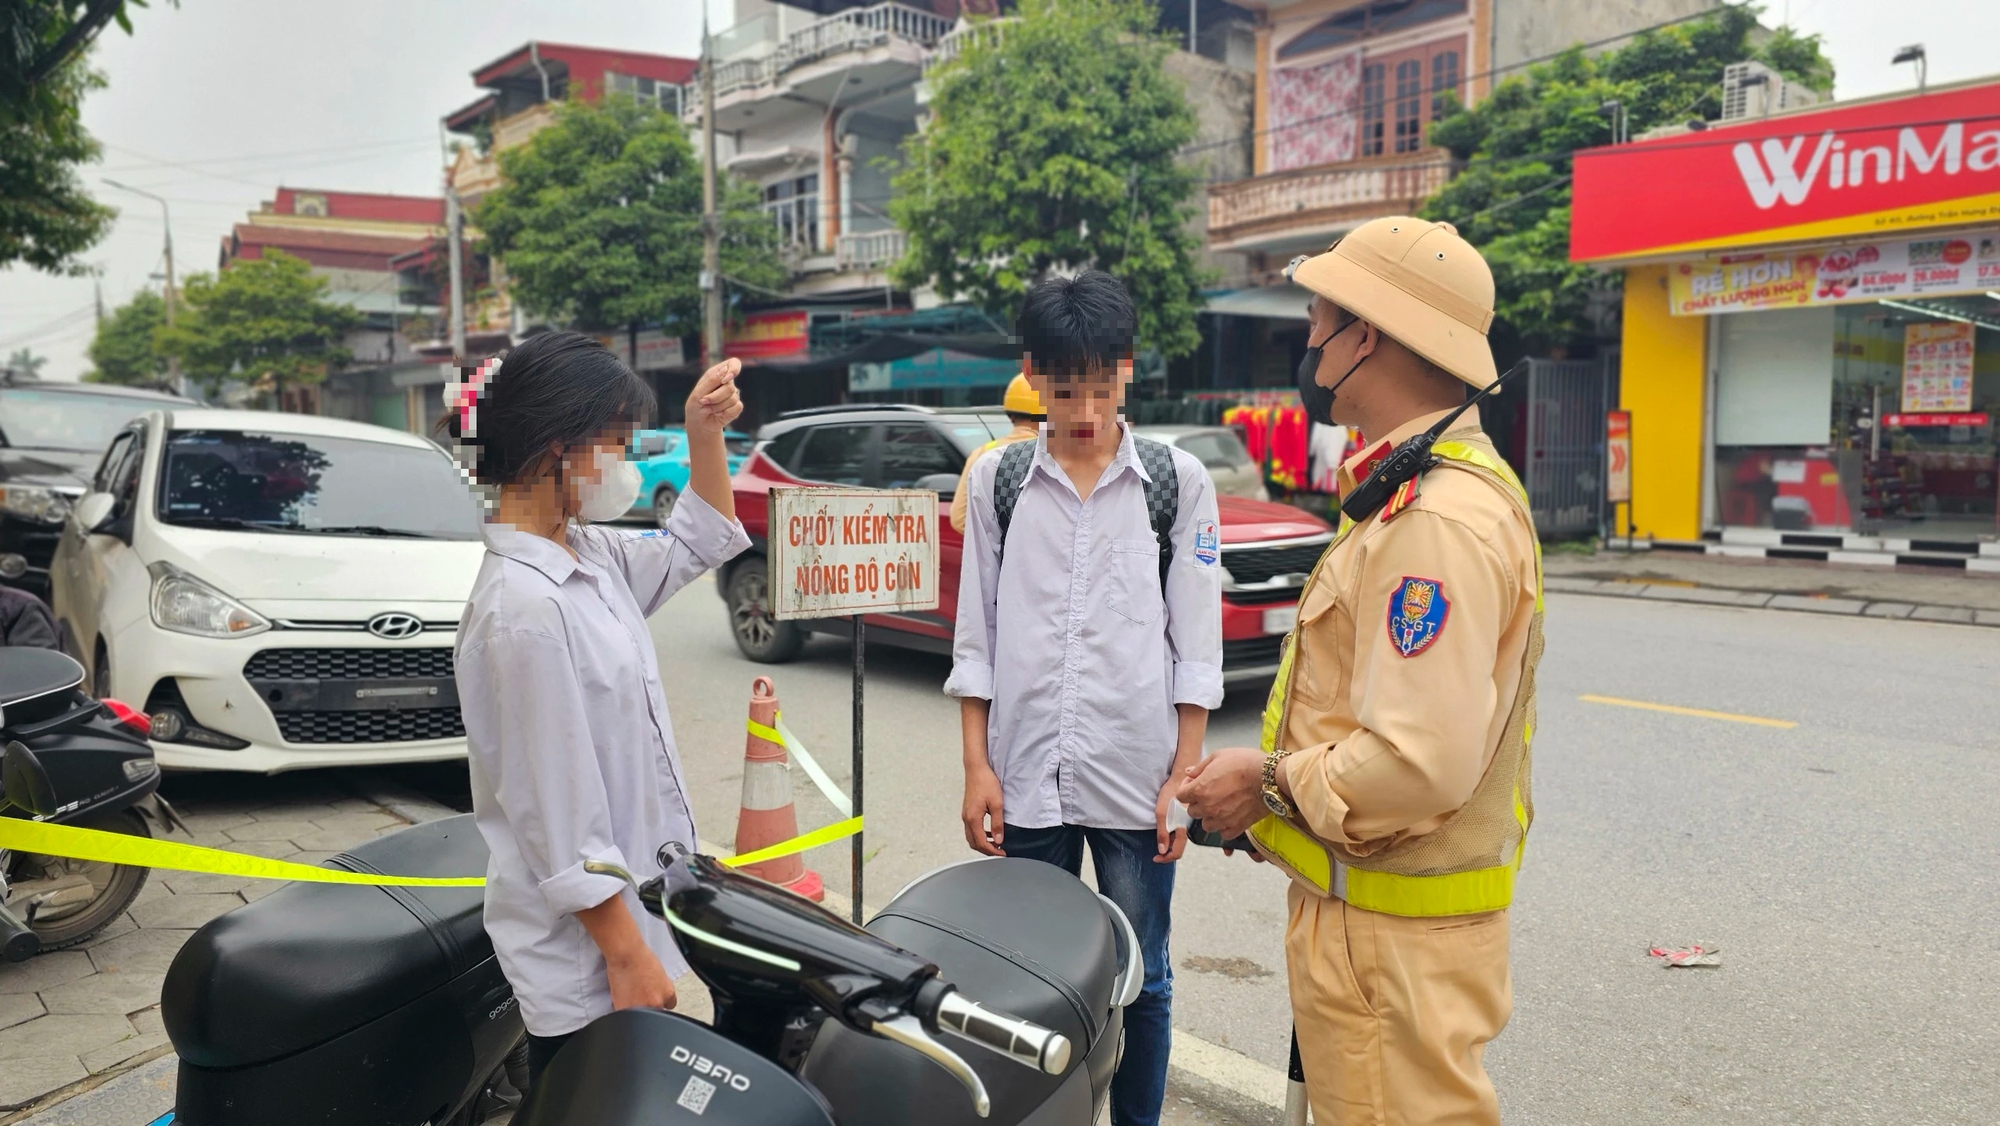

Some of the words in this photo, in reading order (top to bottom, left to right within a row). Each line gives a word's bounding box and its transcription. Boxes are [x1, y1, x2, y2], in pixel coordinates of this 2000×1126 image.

[1732, 257, 1792, 288] HƠN
[843, 503, 888, 546] KIỂM
[894, 515, 928, 544] TRA
[796, 555, 850, 597] NỒNG
[854, 556, 879, 600] ĐỘ
[885, 552, 921, 592] CỒN
